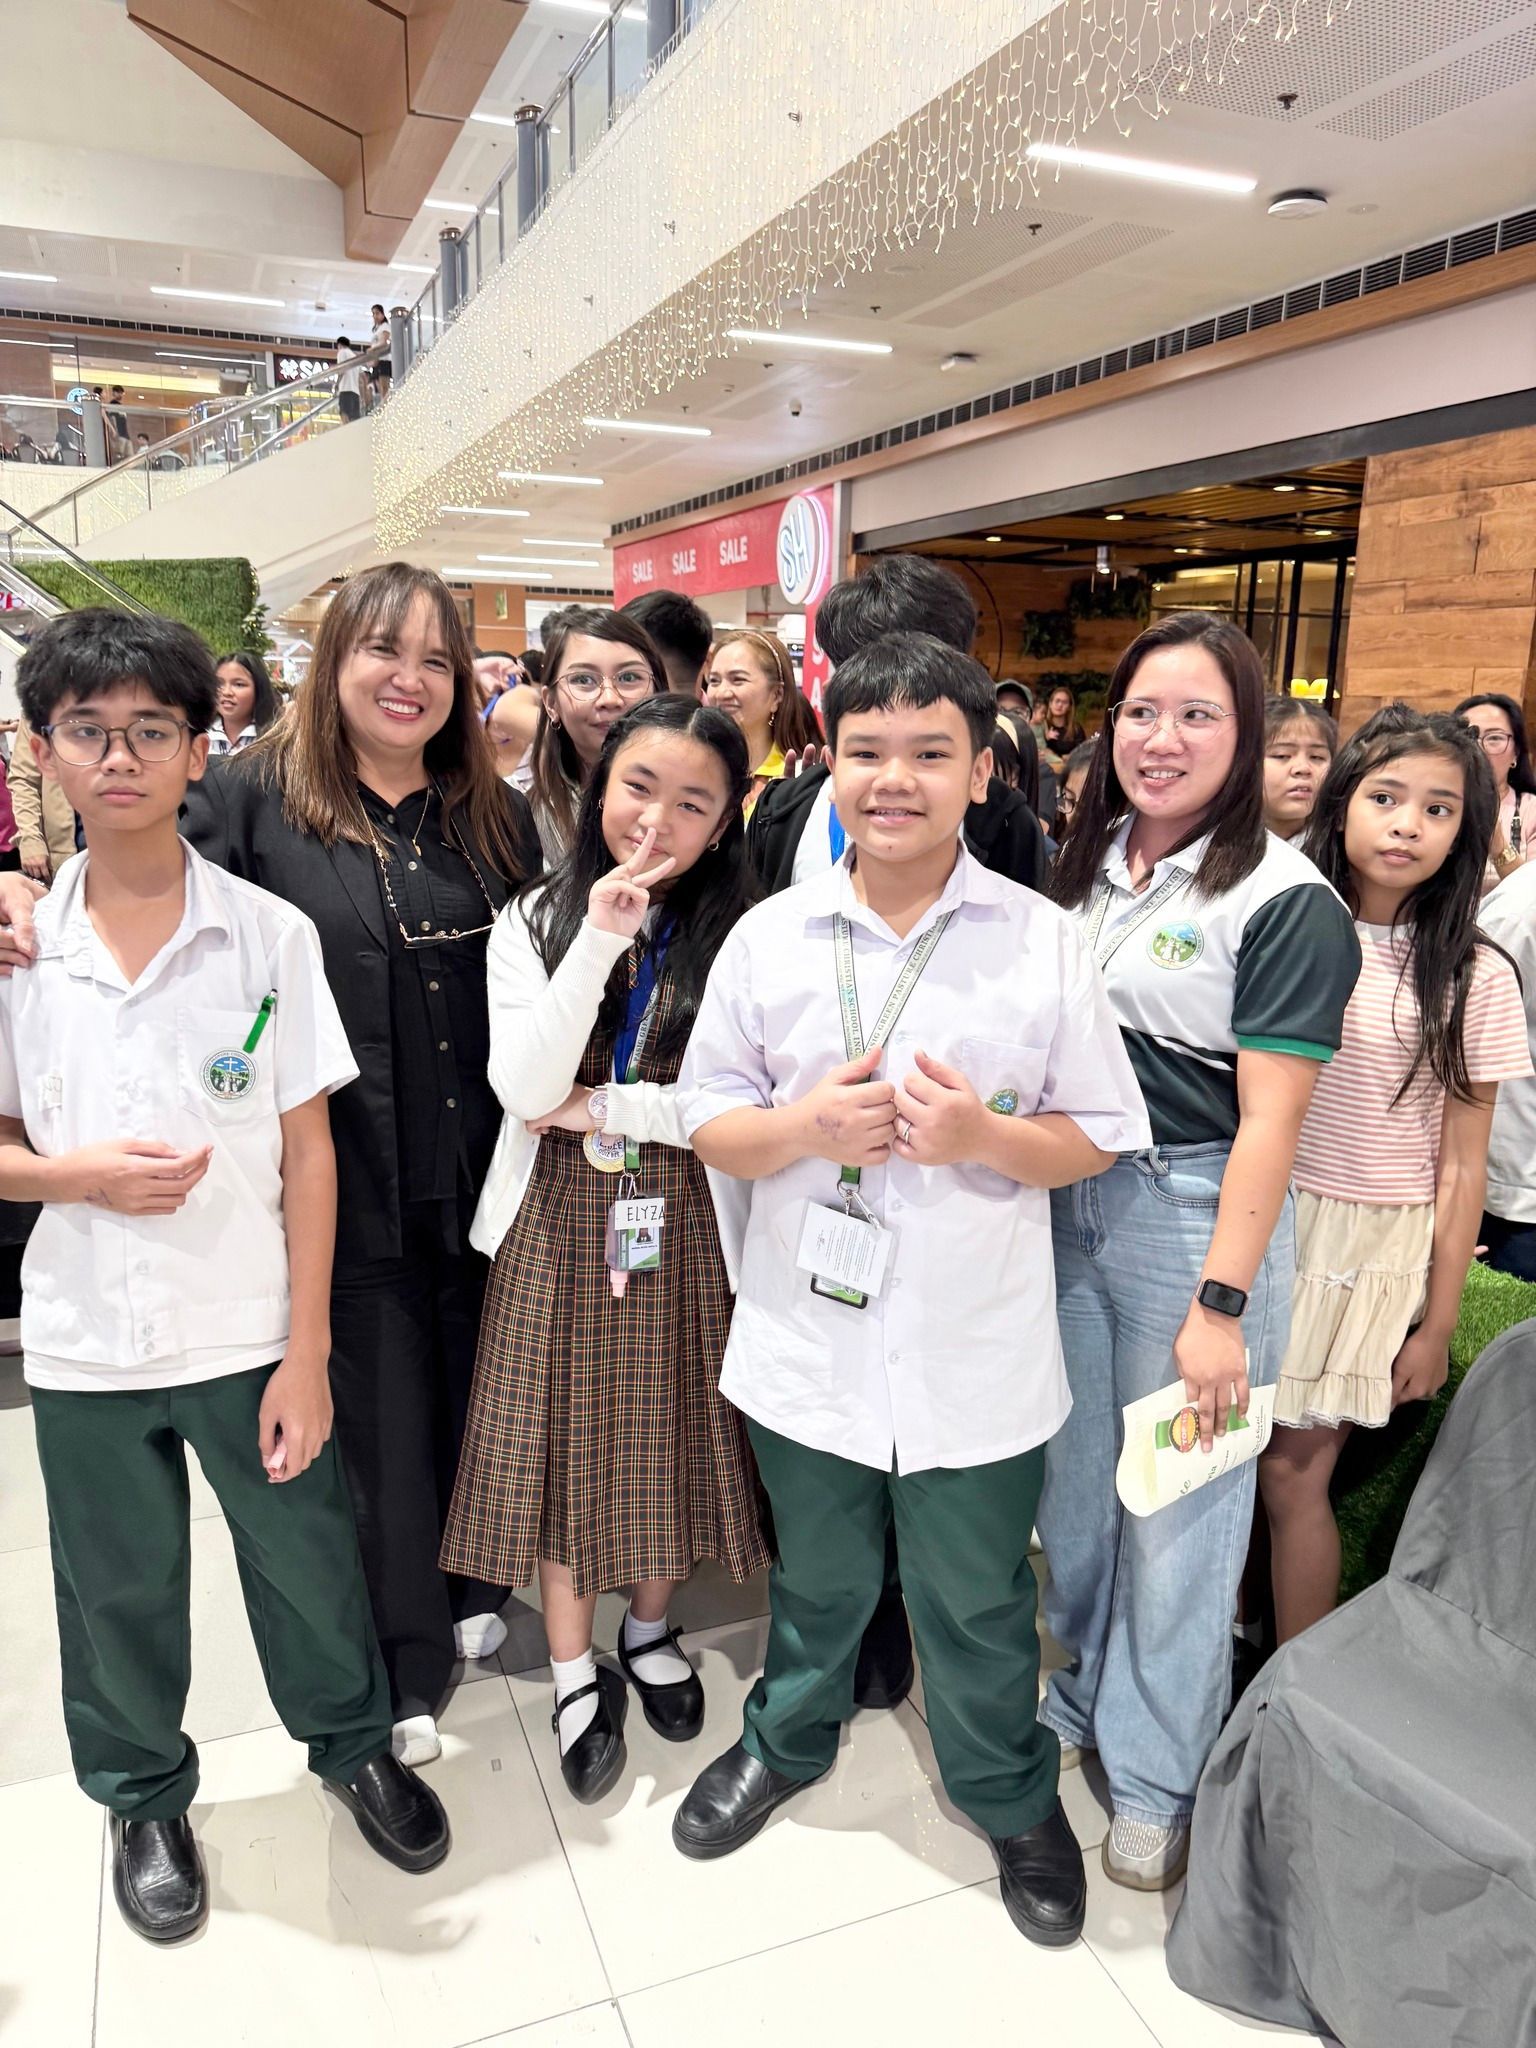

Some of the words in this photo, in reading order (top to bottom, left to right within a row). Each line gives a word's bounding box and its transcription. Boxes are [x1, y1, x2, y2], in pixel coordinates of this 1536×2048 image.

[633, 559, 653, 584] SALE
[672, 548, 696, 576] SALE
[720, 536, 748, 566] SALE
[843, 948, 855, 994] CHRISTIAN
[847, 995, 860, 1035] SCHOOL
[878, 1001, 896, 1031] GREEN
[893, 961, 917, 999] PASTURE
[633, 1039, 644, 1062] PASIG
